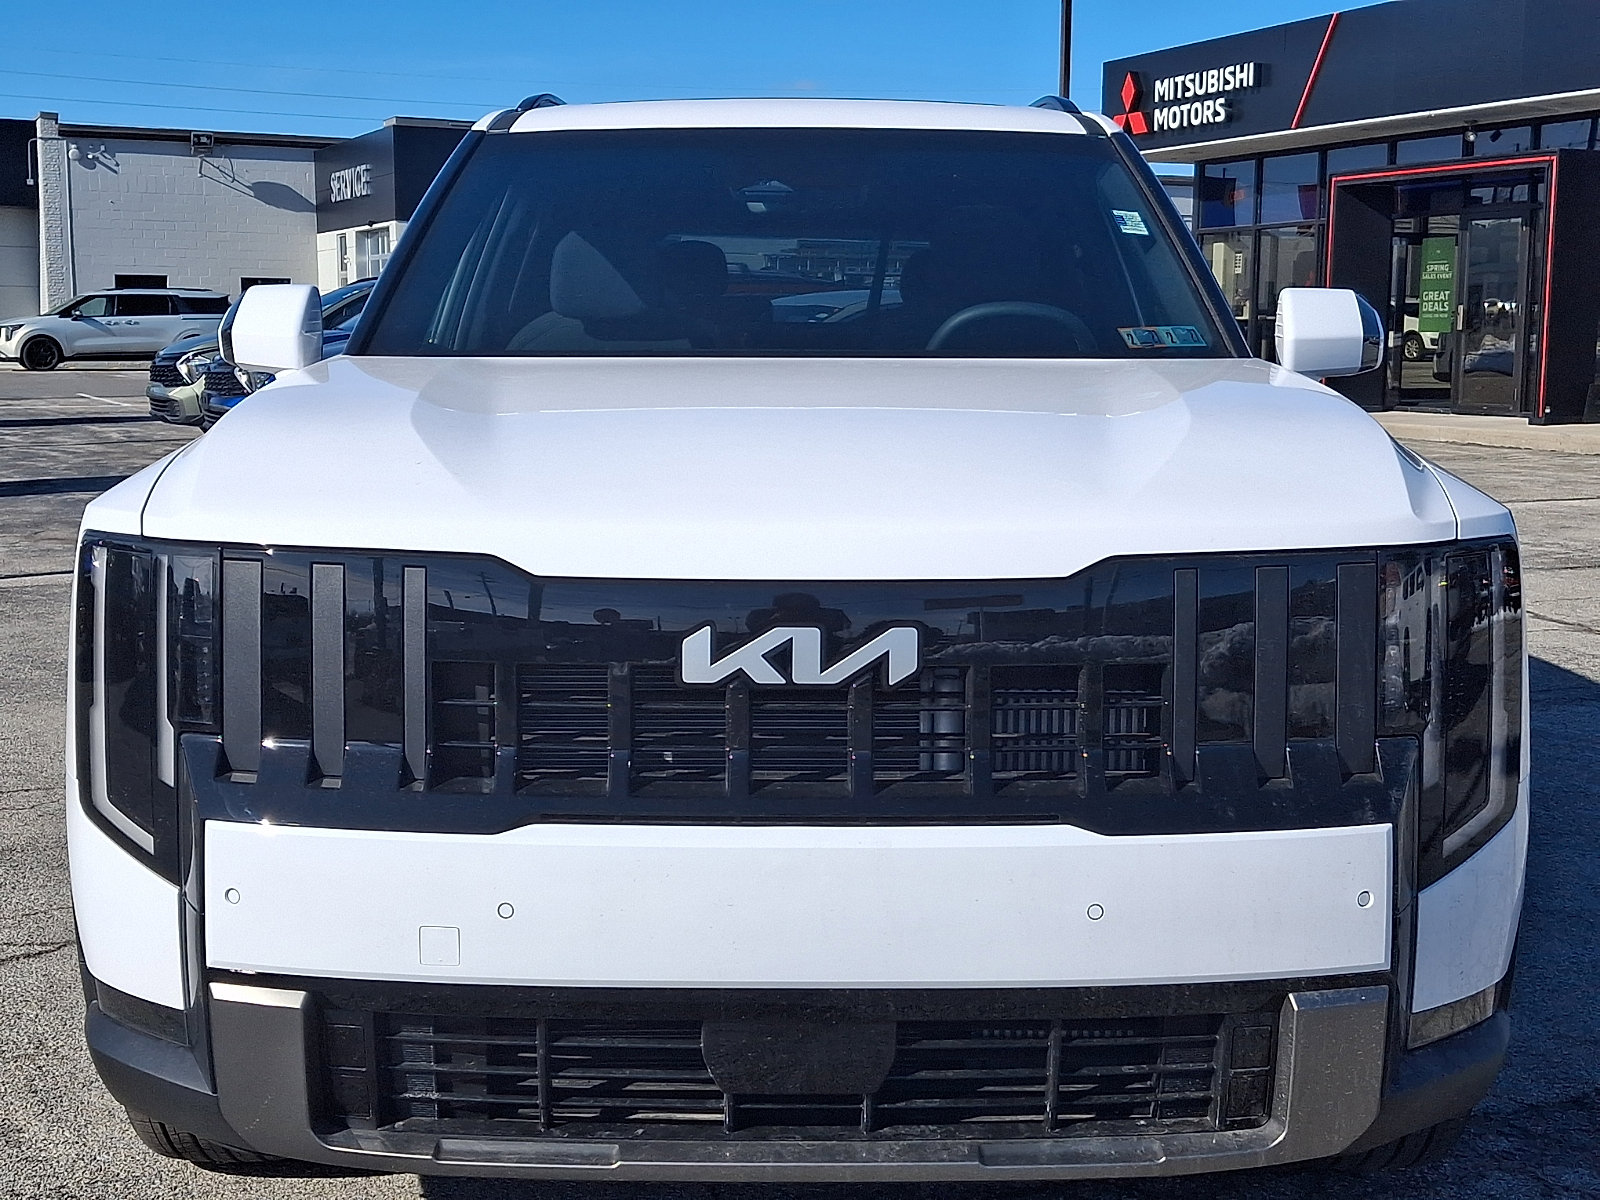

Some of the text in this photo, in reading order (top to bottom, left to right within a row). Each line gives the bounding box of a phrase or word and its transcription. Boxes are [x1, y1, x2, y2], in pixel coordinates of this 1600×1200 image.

[1154, 62, 1254, 103] MITSUBISHI
[1153, 97, 1226, 132] MOTORS
[330, 164, 368, 203] SERVICE
[1426, 264, 1450, 272] SPRING
[1422, 290, 1450, 301] GREAT
[1422, 301, 1449, 312] DEALS
[681, 624, 919, 686] KIA
